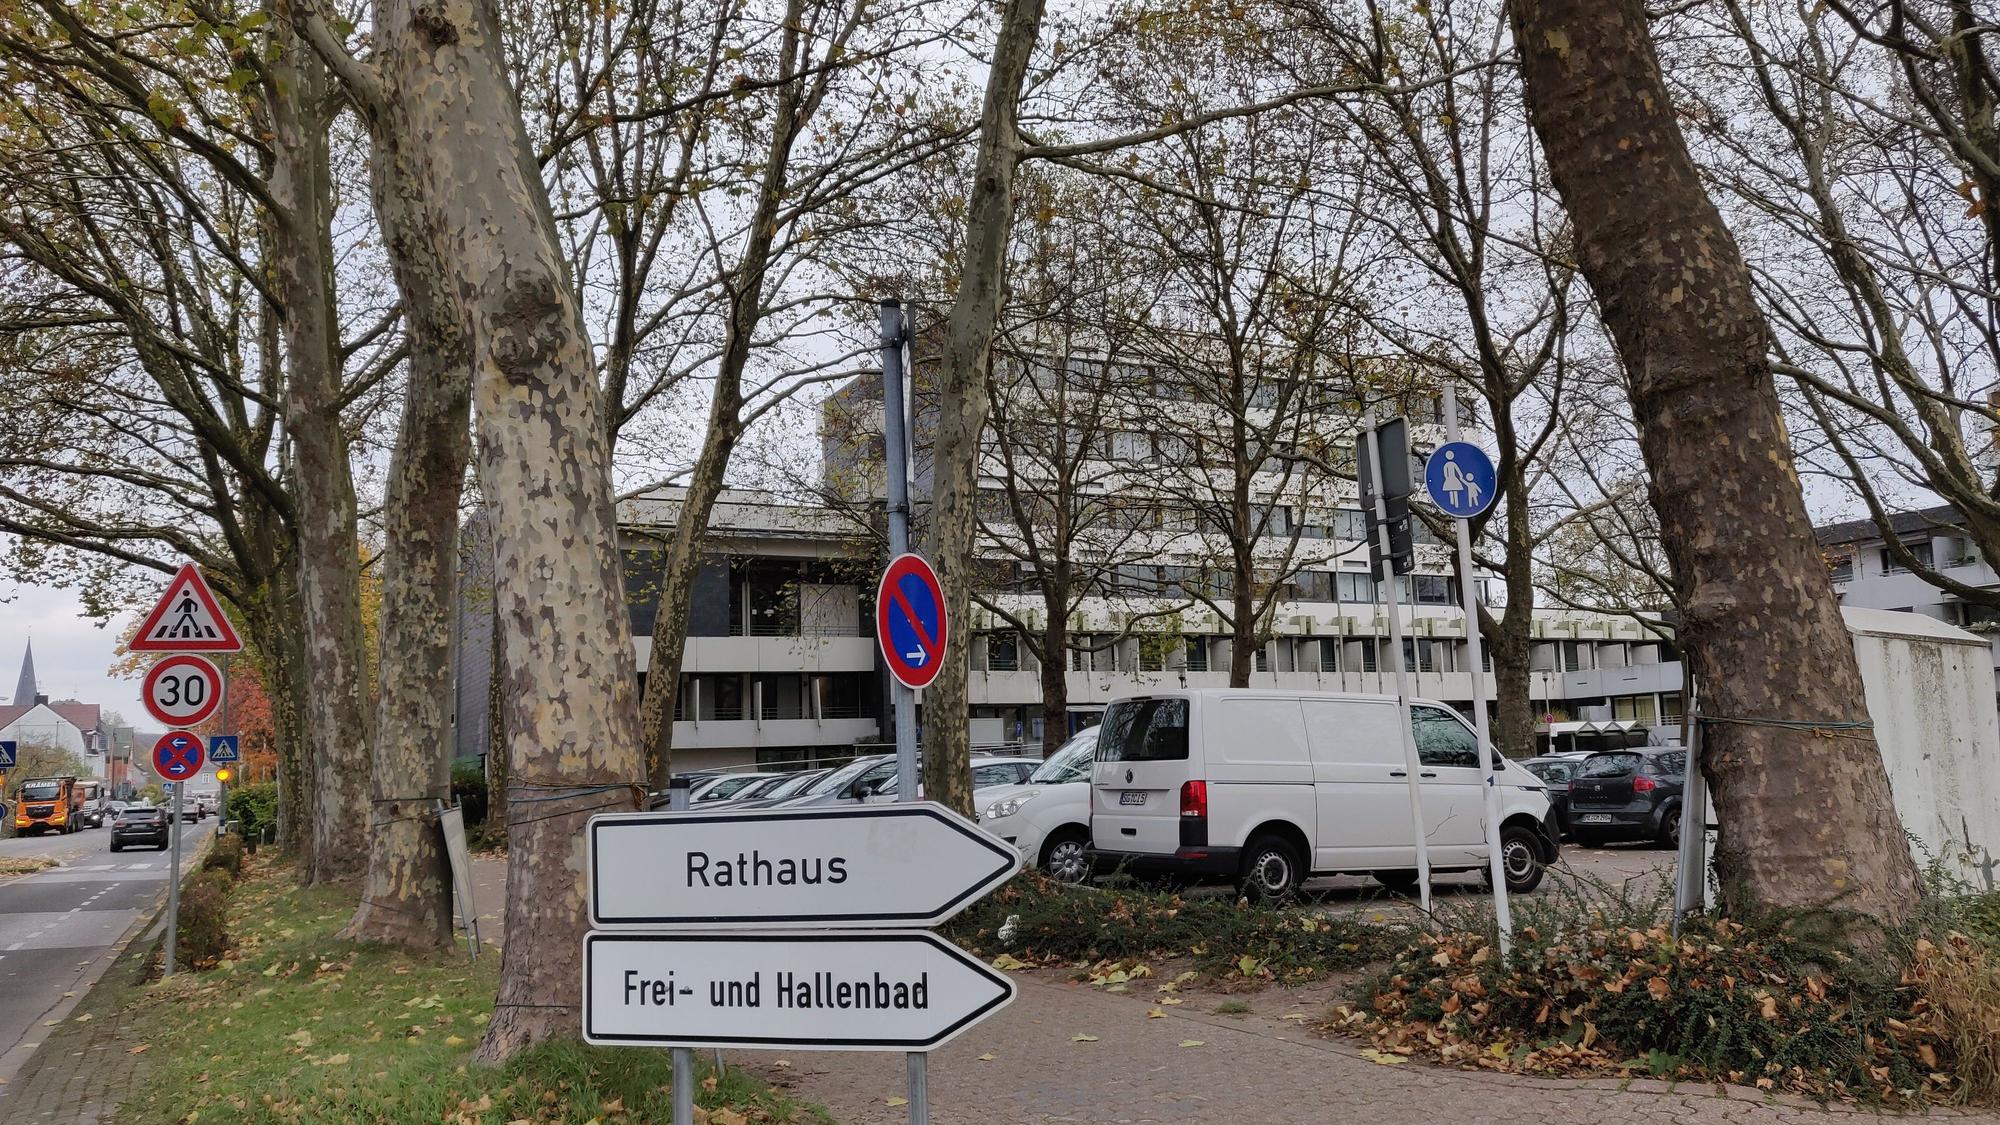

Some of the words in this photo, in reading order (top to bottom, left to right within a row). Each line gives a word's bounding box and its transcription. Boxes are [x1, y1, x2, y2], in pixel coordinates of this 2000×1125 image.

[160, 675, 204, 707] 30
[686, 850, 848, 888] Rathaus
[624, 970, 693, 1006] Frei-
[709, 971, 760, 1008] und
[776, 971, 929, 1009] Hallenbad
